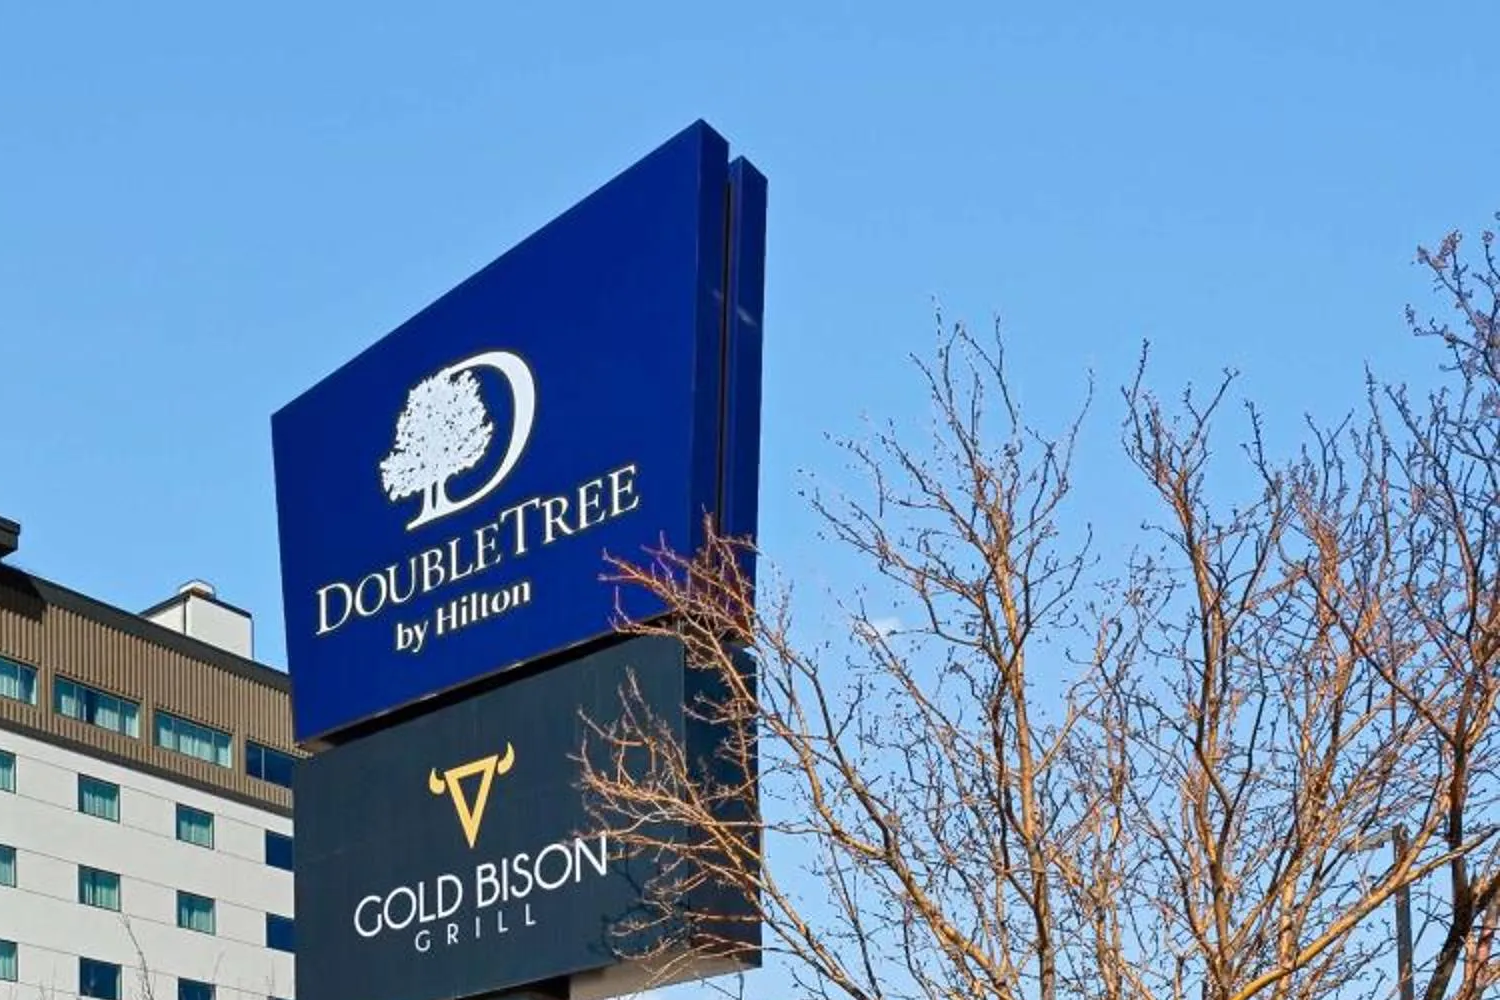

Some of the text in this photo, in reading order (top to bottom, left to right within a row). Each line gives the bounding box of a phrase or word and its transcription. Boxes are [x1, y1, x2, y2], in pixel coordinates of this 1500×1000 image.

[315, 464, 639, 635] DOUBLETREE
[396, 582, 531, 652] by Hilton
[353, 832, 609, 938] GOLD BISON
[414, 904, 537, 953] GRILL
